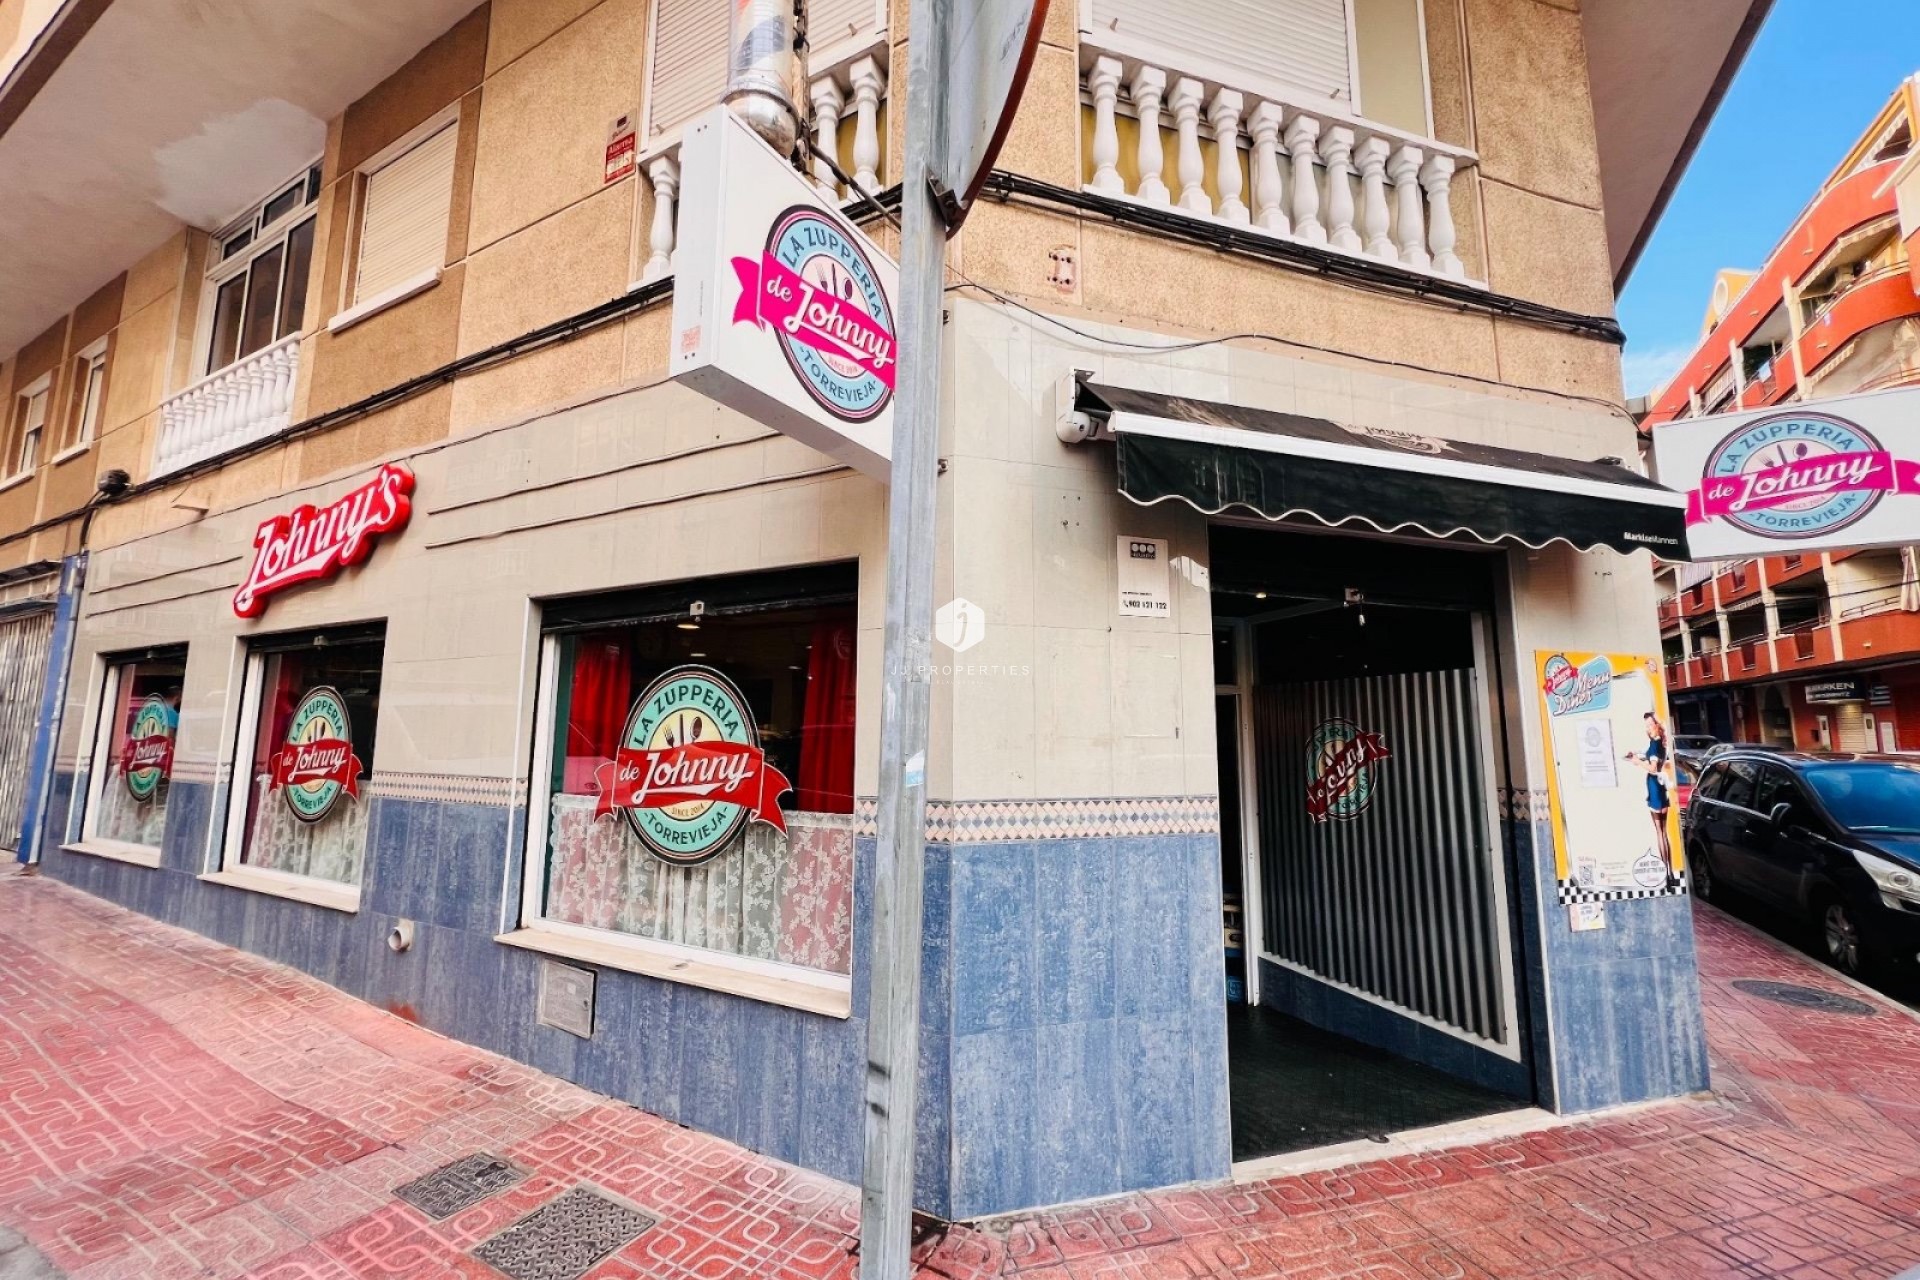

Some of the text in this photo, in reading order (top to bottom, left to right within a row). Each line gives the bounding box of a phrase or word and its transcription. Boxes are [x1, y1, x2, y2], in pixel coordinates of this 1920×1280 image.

[783, 226, 883, 319] LA ZUPPERIA
[766, 275, 793, 302] de
[782, 281, 895, 369] Johnny
[1720, 422, 1856, 474] LA ZUPPERIA
[1708, 454, 1885, 512] de Johnny
[234, 470, 400, 612] Johnny's
[303, 699, 344, 737] ZUPPERIA
[634, 684, 740, 747] LA ZUPPERIA
[1552, 691, 1593, 717] Diner
[282, 744, 348, 783] de Johnny
[619, 751, 755, 805] de Johnny
